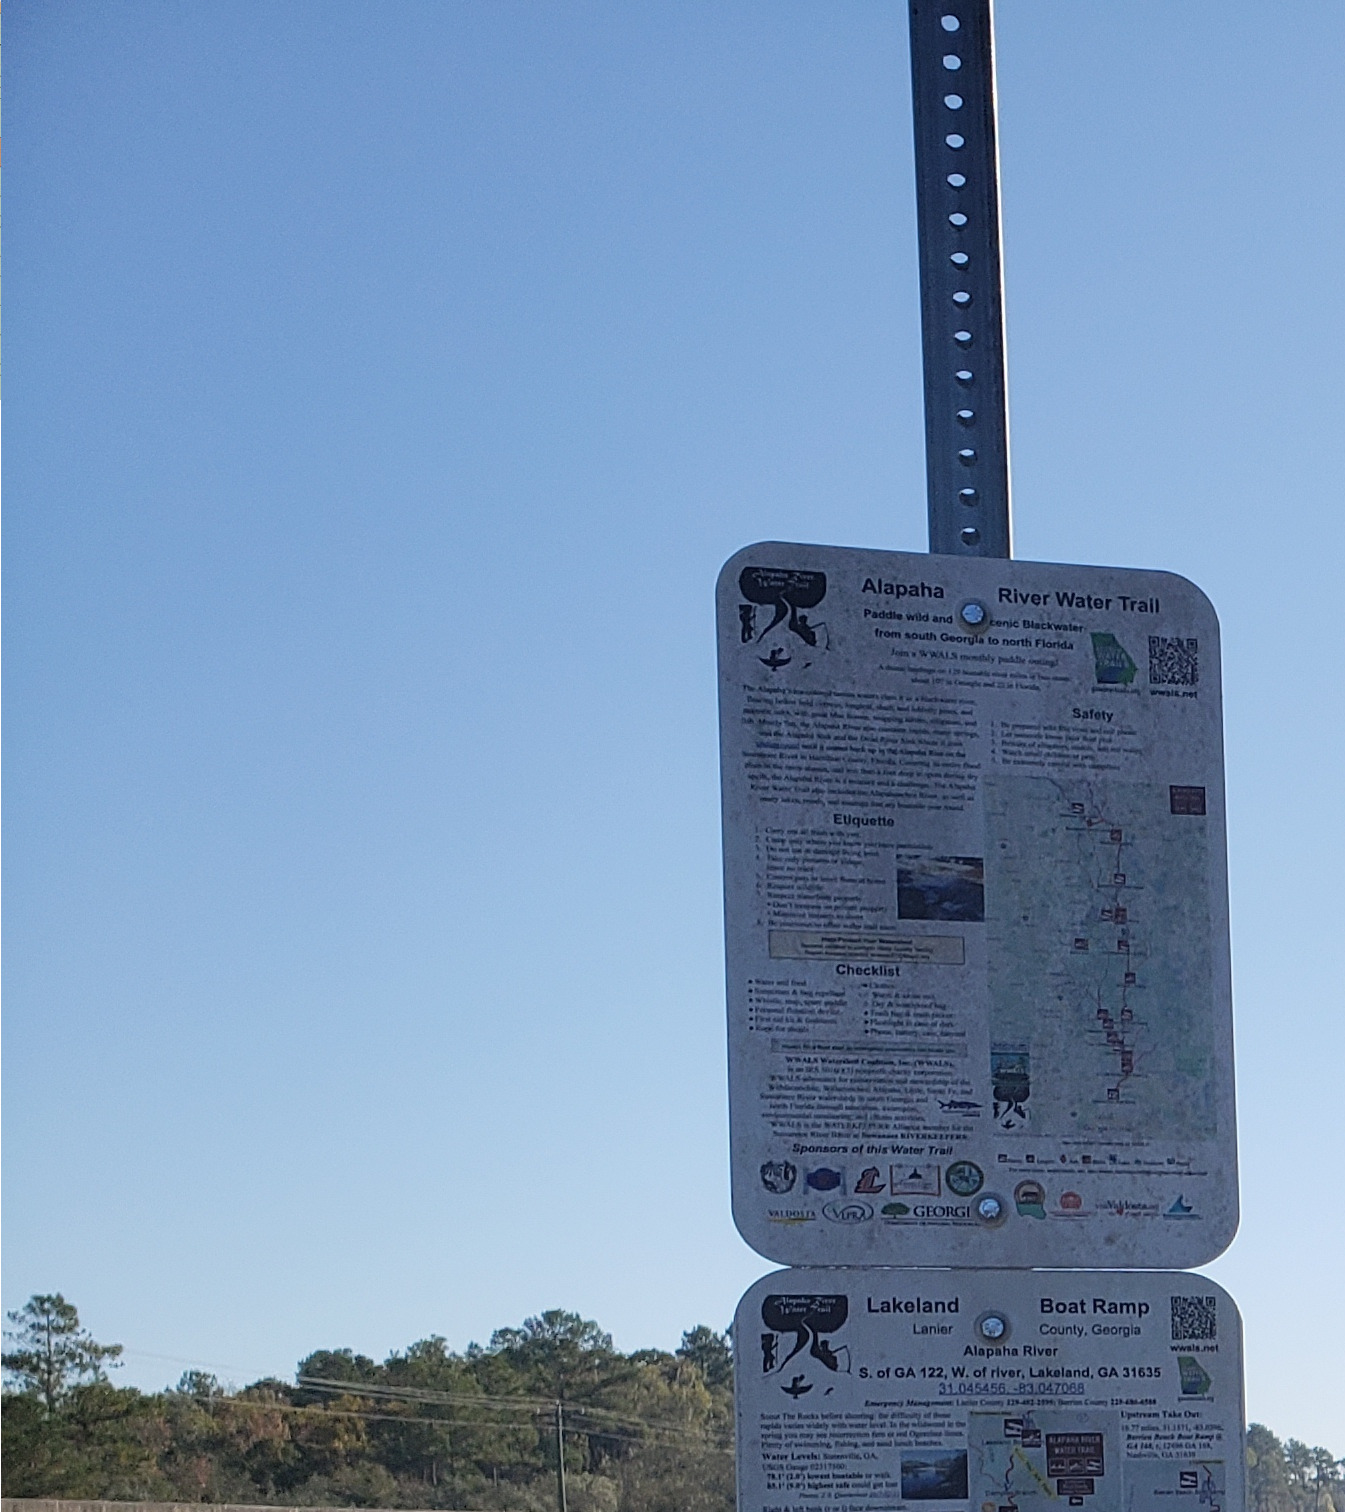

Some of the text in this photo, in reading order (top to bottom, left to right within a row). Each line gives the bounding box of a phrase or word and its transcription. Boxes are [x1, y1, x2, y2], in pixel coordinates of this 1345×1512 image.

[861, 577, 1160, 614] Alapaha River Water Trail
[863, 608, 1084, 632] Paddle wild and cenic Blackwater
[875, 628, 1074, 650] from south Georgia to north Florida
[919, 650, 958, 660] WWALS
[960, 653, 995, 664] monthly
[1150, 689, 1197, 699] wwals.net
[1072, 707, 1114, 722] Safety
[833, 813, 895, 828] Etiquette
[835, 964, 900, 977] Checklist
[792, 1143, 953, 1156] Sponsors of this Water Trail
[913, 1206, 971, 1218] GEORGI
[867, 1296, 1150, 1318] Lakeland Boat Ramp
[912, 1323, 1142, 1338] Lanier County, Georgia
[964, 1345, 1058, 1358] Alapaha River
[1170, 1345, 1219, 1353] wwals.net
[858, 1366, 1162, 1380] S. of GA 122, W. of river, Lakeland, GA 31635
[938, 1382, 1008, 1395] 31.045456,
[783, 1412, 795, 1420] The
[1121, 1411, 1160, 1420] Upstream
[1163, 1410, 1182, 1419] Take
[761, 1452, 788, 1461] Water
[791, 1452, 820, 1461] Levels:
[807, 1481, 834, 1490] highest
